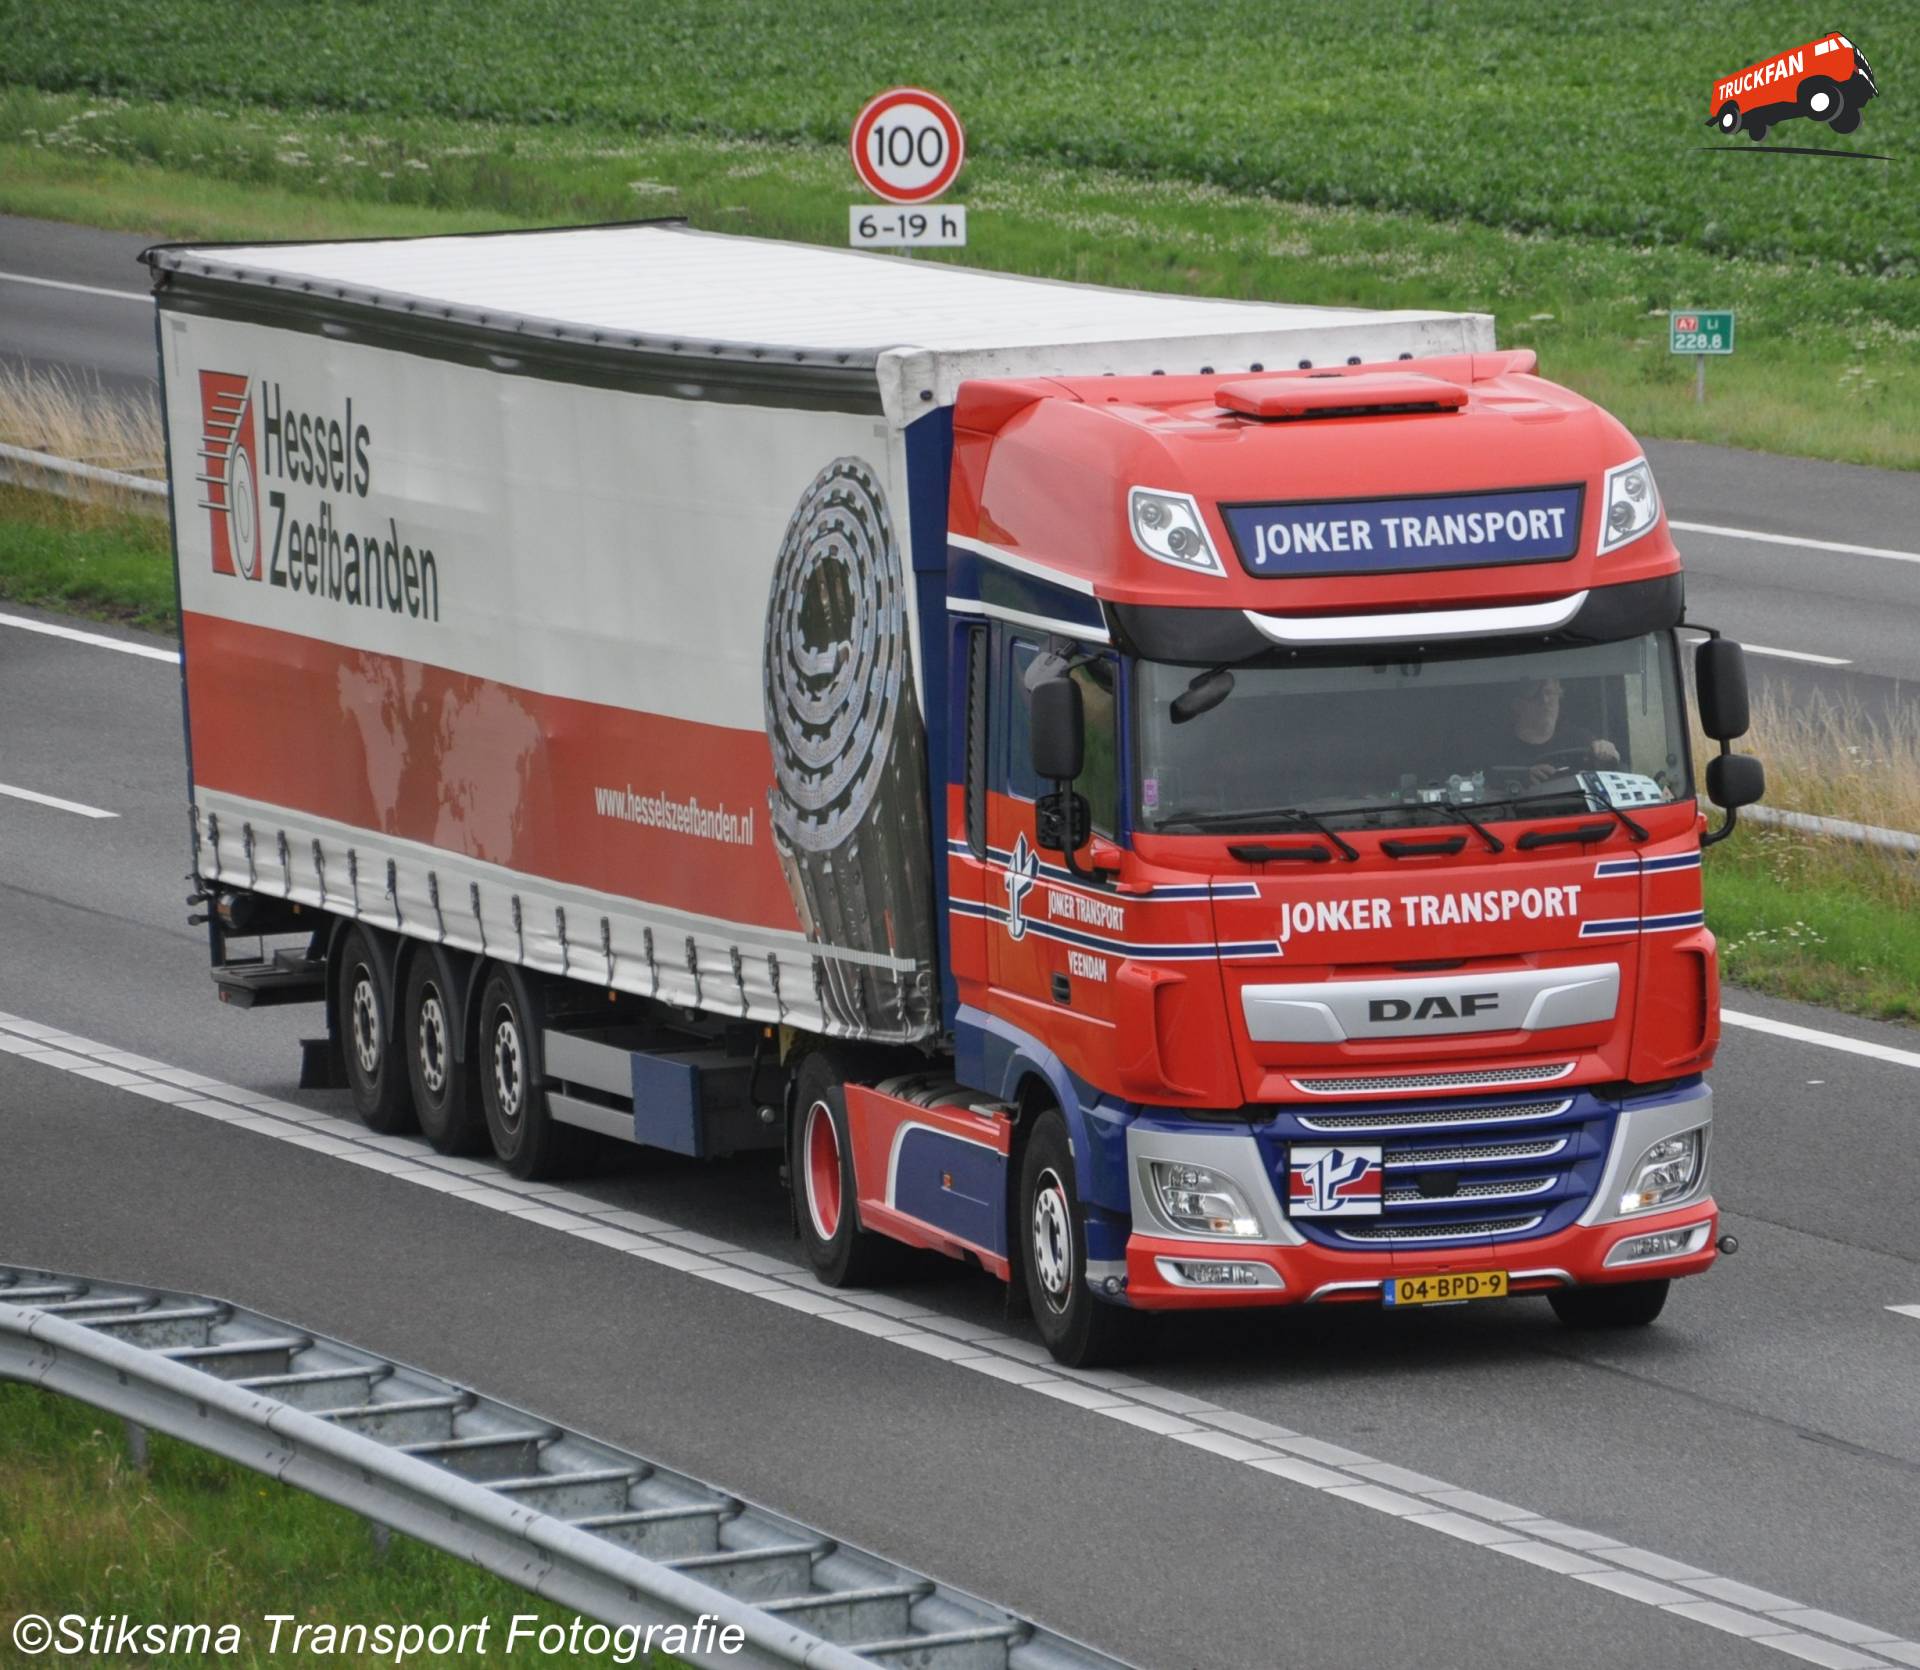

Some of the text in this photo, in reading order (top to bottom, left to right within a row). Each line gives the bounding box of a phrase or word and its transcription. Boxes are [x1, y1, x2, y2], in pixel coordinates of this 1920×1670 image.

[873, 126, 943, 167] 100
[859, 214, 957, 238] 6-19 h
[1675, 334, 1722, 349] 228.8
[1679, 319, 1696, 330] A7
[262, 380, 370, 498] Hessels
[269, 490, 439, 622] Zeefbanden
[1255, 508, 1566, 564] JONKER TRANSPORT
[595, 784, 753, 845] www.hesselszeefbanden.nl
[1048, 890, 1125, 931] JONKER TRANSPORT
[1280, 885, 1581, 942] JONKER TRANSPORT
[1068, 950, 1107, 982] VEENDAM
[1369, 993, 1499, 1022] DAF
[1401, 1275, 1501, 1299] 04-BPD-9
